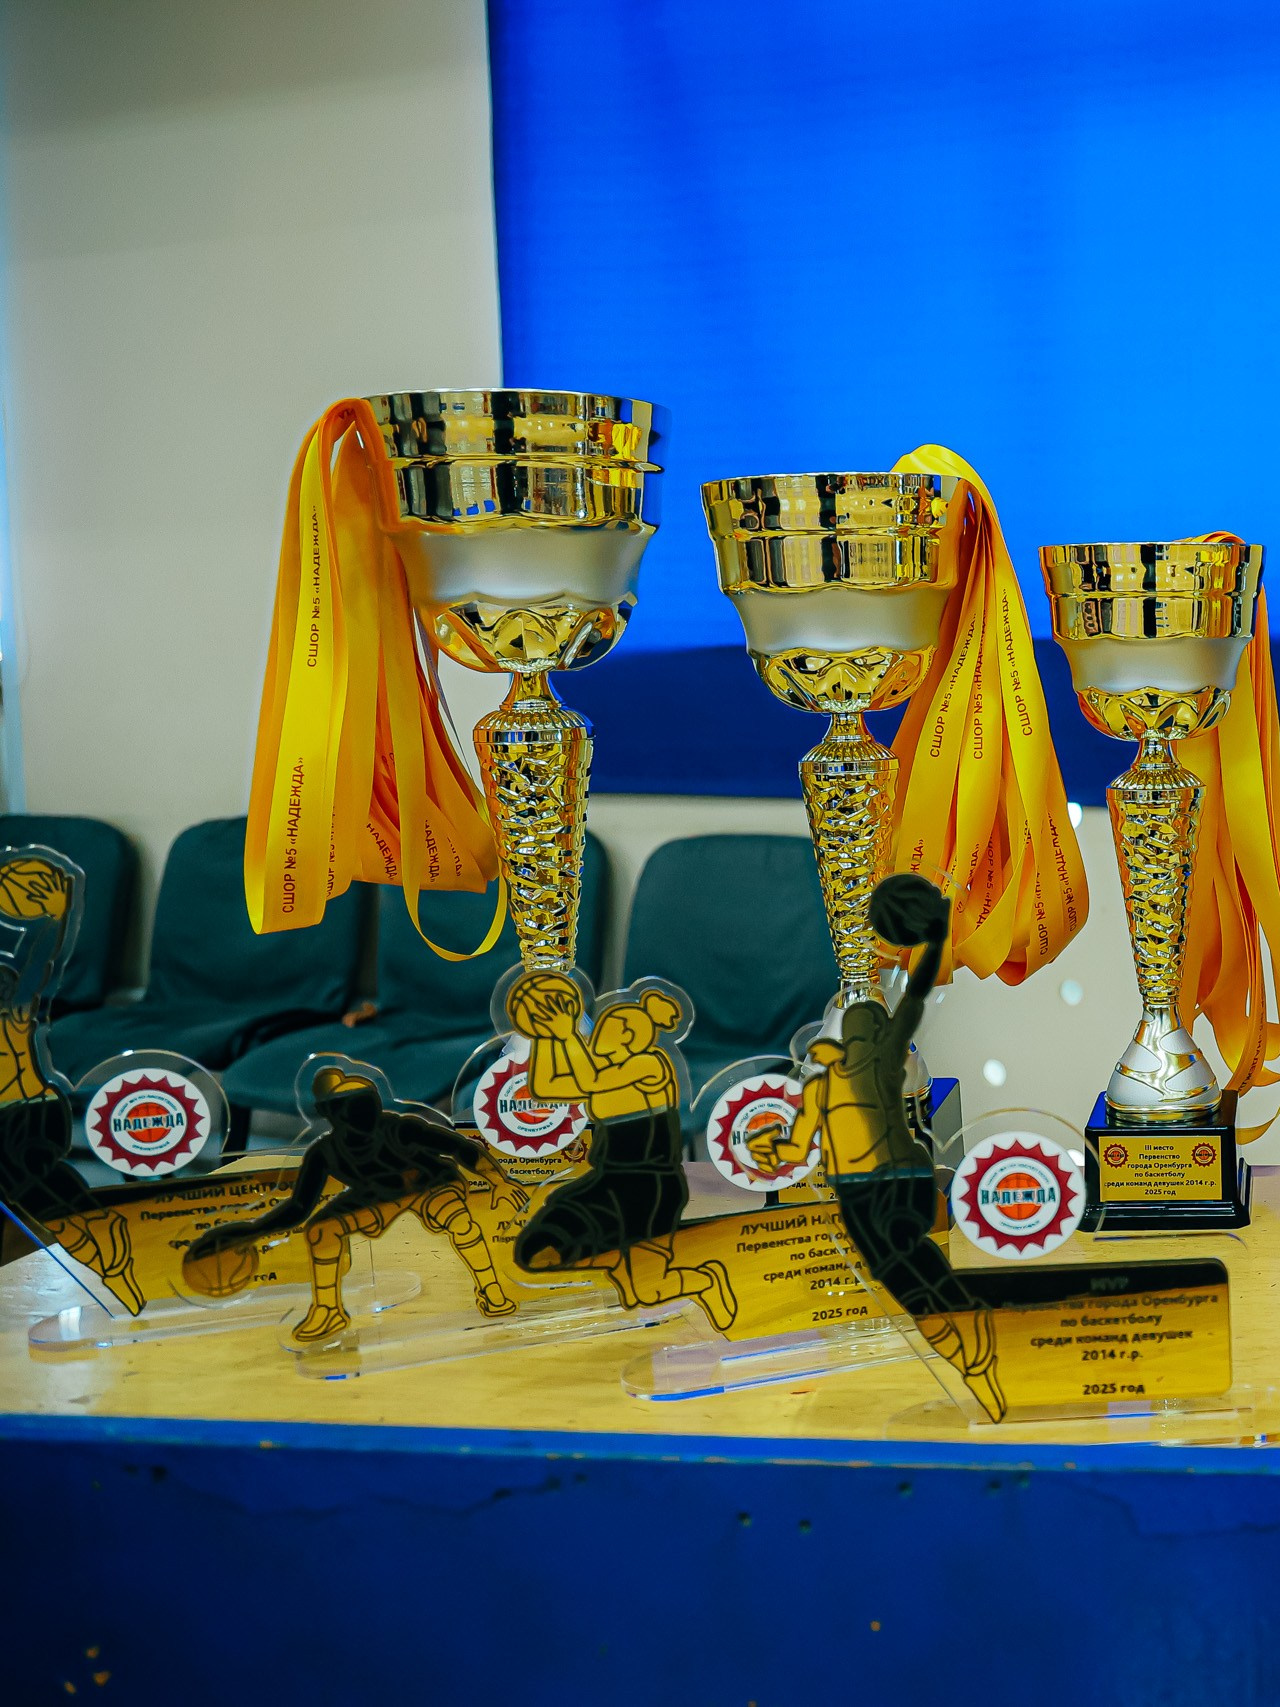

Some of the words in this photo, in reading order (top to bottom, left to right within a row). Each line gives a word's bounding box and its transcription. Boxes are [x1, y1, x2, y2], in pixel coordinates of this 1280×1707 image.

[313, 505, 321, 594] «НАДЕЖДА»
[312, 597, 321, 619] №5
[1002, 588, 1019, 668] «НАДЕЖДА»
[307, 623, 319, 667] СШОР
[930, 716, 944, 758] СШОР
[941, 692, 952, 713] №5
[949, 613, 977, 689] «НАДЕЖДА»
[1010, 669, 1022, 690] №5
[974, 692, 983, 714] №5
[1014, 692, 1032, 736] СШОР
[974, 718, 983, 760] СШОР
[287, 757, 304, 845] «НАДЕЖДА»
[284, 848, 297, 870] №5
[282, 874, 294, 913] СШОР
[1034, 900, 1046, 921] №5
[1039, 923, 1048, 955] СШОР
[113, 1112, 184, 1132] НАДЕЖДА
[519, 1157, 562, 1165] Оренбурга
[1153, 1162, 1193, 1170] Оренбурга
[1144, 1171, 1185, 1179] баскетболу
[229, 1181, 296, 1197] ЦЕНТРО
[739, 1214, 807, 1236] ЛУЧШИЙ
[736, 1234, 812, 1254] Первенства
[790, 1251, 805, 1261] по
[763, 1269, 801, 1283] среди
[810, 1276, 841, 1291] 2014
[812, 1307, 843, 1322] 2025
[846, 1305, 868, 1316] год
[1060, 1318, 1077, 1328] по
[1080, 1313, 1163, 1327] баскетболу
[1030, 1335, 1072, 1349] среди
[1075, 1333, 1128, 1345] команд
[1131, 1329, 1193, 1343] девушек
[1081, 1350, 1115, 1361] 2014
[1119, 1350, 1144, 1362] г.р.
[1083, 1384, 1117, 1396] 2025
[1120, 1384, 1145, 1395] год
